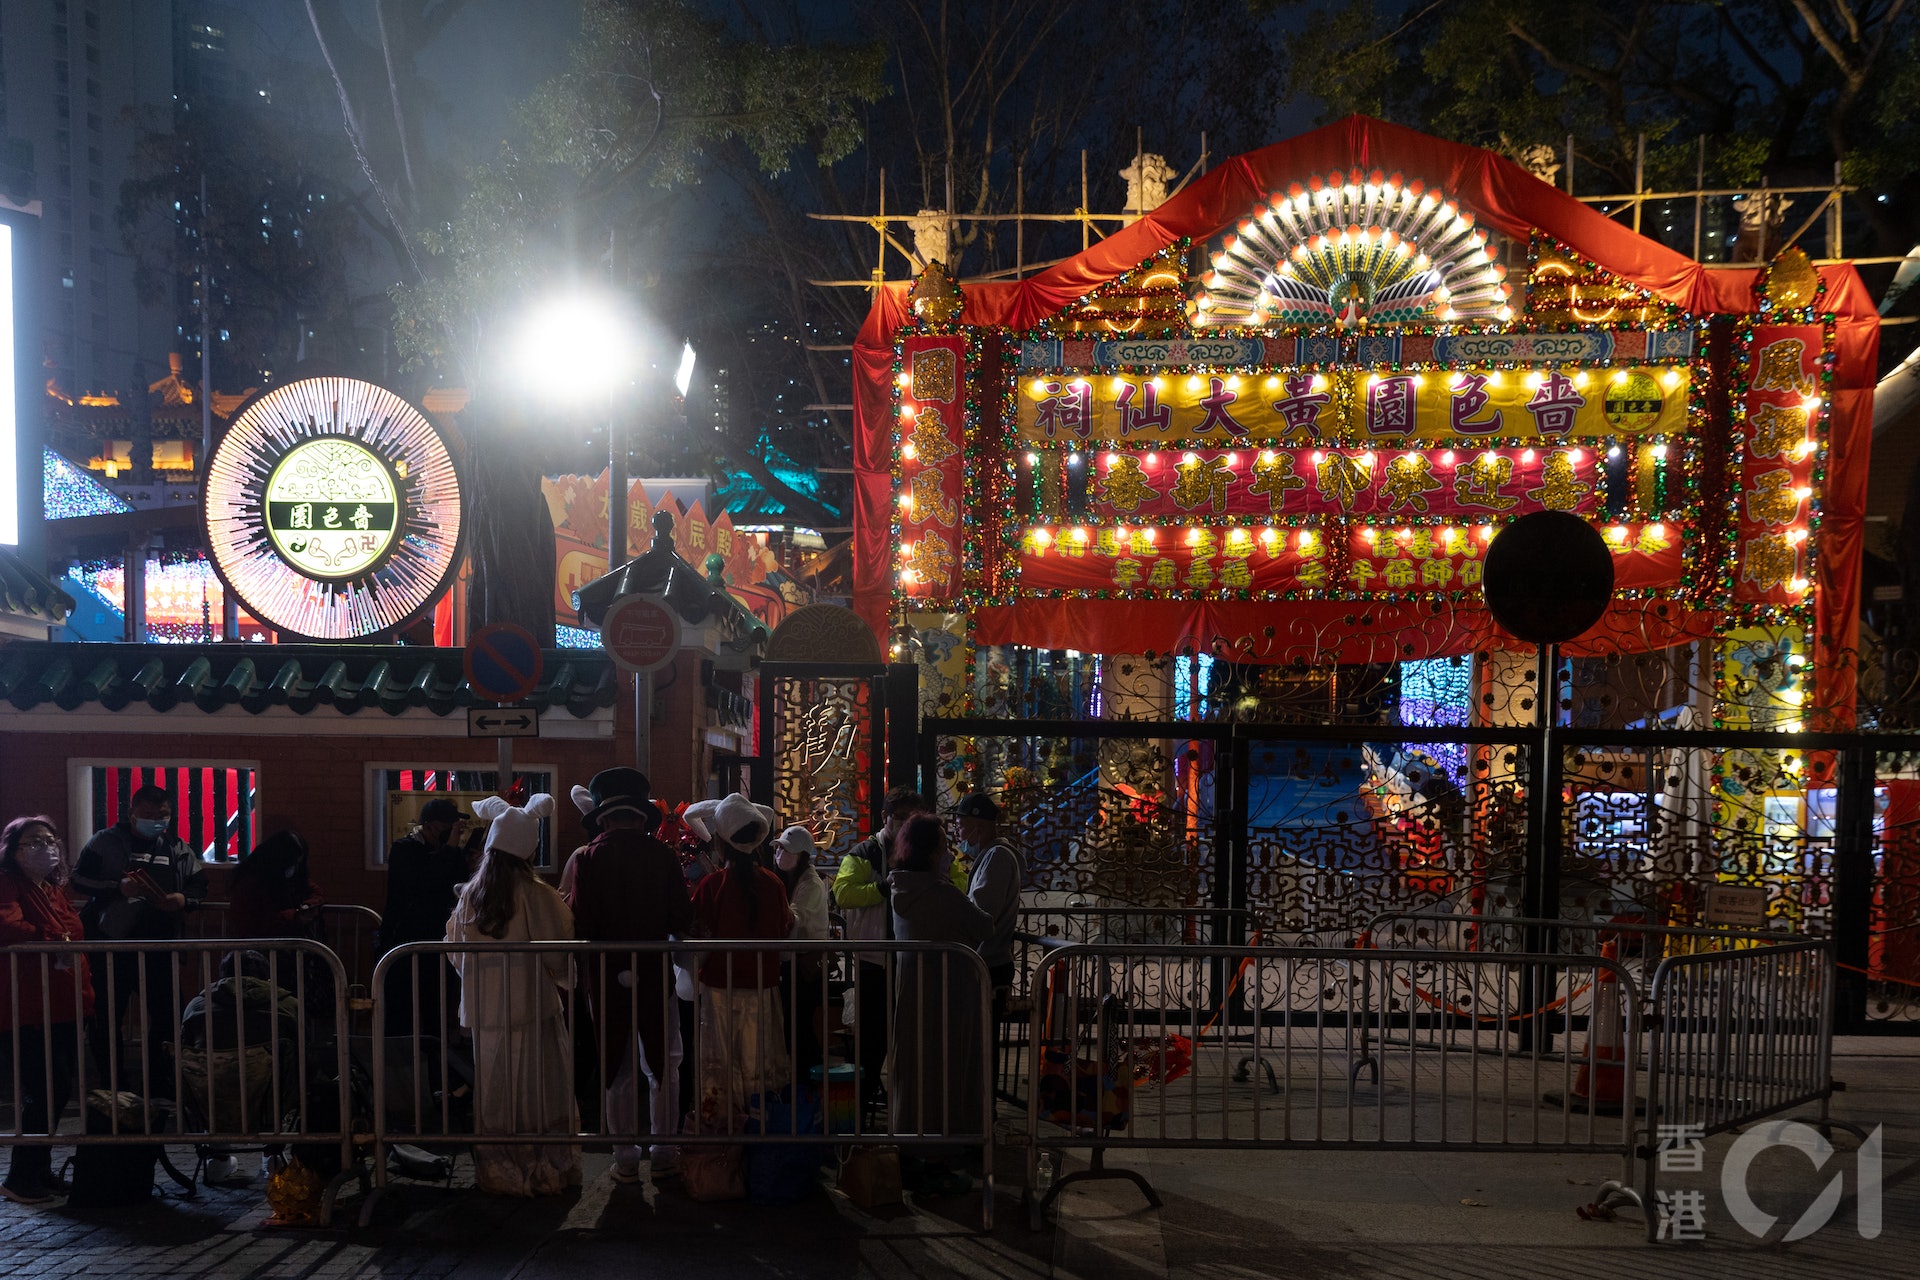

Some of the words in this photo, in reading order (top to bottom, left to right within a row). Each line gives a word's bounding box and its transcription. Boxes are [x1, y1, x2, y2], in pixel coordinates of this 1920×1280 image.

[289, 502, 374, 531] 嗇色園
[906, 347, 959, 586] 國泰民安
[1742, 337, 1815, 594] 風調雨順
